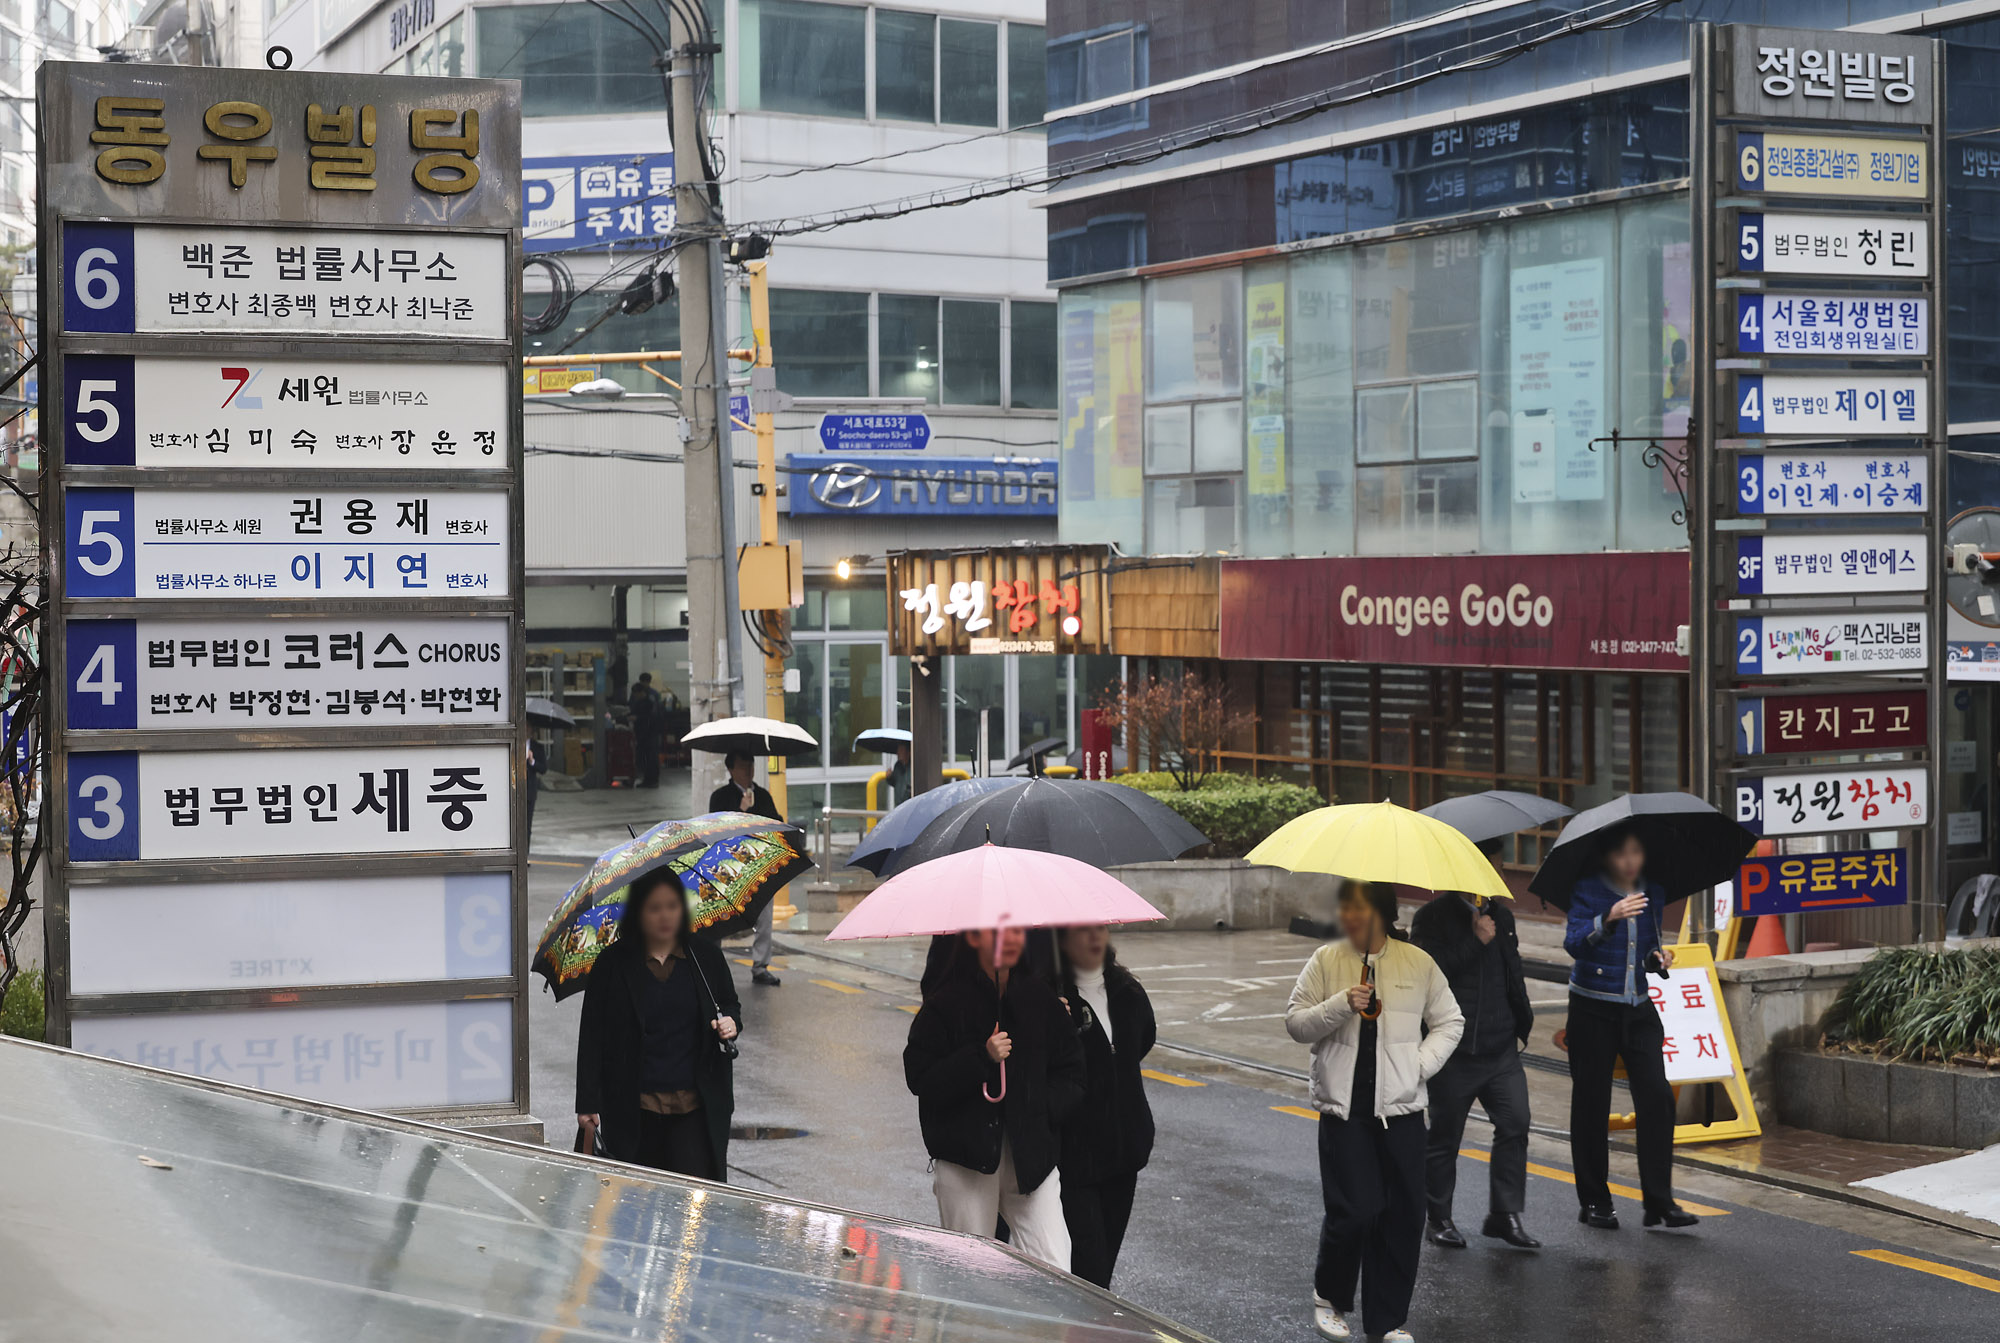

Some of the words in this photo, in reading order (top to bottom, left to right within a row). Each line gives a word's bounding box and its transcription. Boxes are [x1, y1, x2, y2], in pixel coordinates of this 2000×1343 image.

[1757, 47, 1916, 103] 정원빌딩
[89, 94, 481, 198] 동우빌딩
[1741, 146, 1759, 181] 6
[1768, 148, 1859, 179] 정원종합건설(주)
[1871, 153, 1919, 183] 정원기업
[617, 166, 674, 198] 유료
[586, 205, 676, 236] 주차장
[1741, 226, 1758, 260] 5
[1775, 235, 1847, 257] 법무법인
[1858, 229, 1914, 267] 청린
[75, 248, 119, 309] 6
[183, 244, 253, 278] 백준
[277, 246, 457, 283] 법률사무소
[169, 292, 239, 316] 변호사
[248, 293, 315, 317] 최종백
[330, 295, 398, 319] 변호사
[407, 297, 473, 320] 최낙준
[1772, 299, 1920, 330] 서울회생법원
[1741, 307, 1760, 340] 4
[1774, 331, 1918, 351] 전임회생위원실(E)
[278, 376, 342, 405] 세원
[349, 391, 428, 405] 법률사무소
[1741, 388, 1760, 421] 4
[1773, 397, 1828, 414] 법무법인
[1836, 389, 1915, 421] 제이엘
[76, 380, 119, 442] 5
[843, 417, 906, 428] 서초대로53길
[148, 430, 200, 450] 변호사
[206, 428, 317, 454] 심미숙
[336, 435, 383, 450] 변호사
[391, 430, 495, 455] 장윤정
[826, 428, 836, 437] 17
[915, 428, 925, 437] 13
[1741, 467, 1758, 502] 3
[1781, 461, 1826, 479] 변호사
[1866, 461, 1910, 479] 변호사
[156, 519, 228, 534] 법률사무소
[233, 519, 261, 534] 세원
[290, 498, 427, 535] 권용재
[446, 520, 488, 535] 변호사
[78, 511, 123, 576] 5
[157, 574, 229, 589] 법률사무소
[234, 574, 277, 589] 하나로
[291, 553, 427, 589] 이지연
[447, 574, 488, 588] 변호사
[1738, 558, 1761, 579] 3F
[1775, 554, 1832, 574] 법무법인
[1841, 549, 1915, 574] 엘앤에스
[1341, 585, 1449, 636] Congee
[1460, 584, 1553, 626] GoGo
[149, 639, 270, 668] 법무법인
[284, 631, 409, 670] 코러스
[419, 643, 500, 662] CHORUS
[1739, 629, 1757, 663] 2
[1769, 627, 1820, 650] LEARNING
[1844, 622, 1921, 645] 맥스러닝랩
[1844, 651, 1860, 661] Tel.
[1862, 647, 1922, 660] 02-532-0858
[77, 645, 122, 705] 4
[151, 693, 217, 714] 변호사
[1741, 710, 1755, 754] 1
[1780, 706, 1910, 739] 칸지고고
[78, 775, 124, 840] 3
[164, 784, 337, 826] 법무법인
[352, 768, 487, 832] 세중
[1773, 777, 1913, 824] 정원참치
[1741, 864, 1769, 910] P
[1780, 853, 1898, 893] 유료주차
